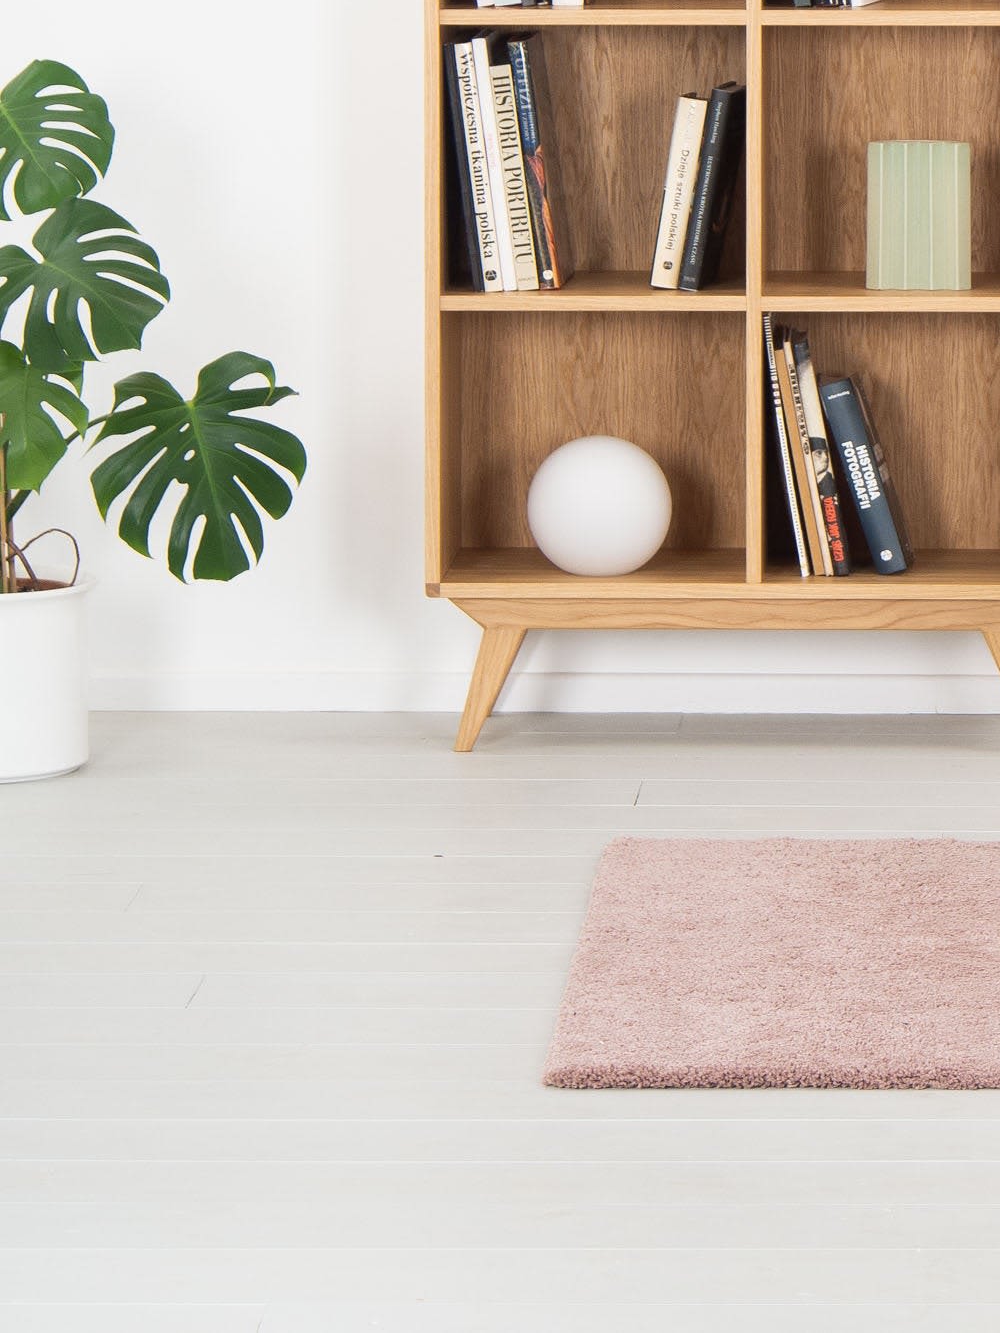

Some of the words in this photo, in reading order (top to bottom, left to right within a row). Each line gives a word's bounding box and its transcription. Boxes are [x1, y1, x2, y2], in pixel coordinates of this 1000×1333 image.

[493, 75, 519, 161] HISTORIA
[710, 121, 720, 144] Hawking
[471, 150, 488, 205] tkanina
[676, 149, 690, 179] Dzieje
[504, 167, 534, 264] PORTRETU
[672, 182, 683, 210] sztuki
[474, 212, 495, 258] polska
[665, 213, 678, 250] polskiej
[693, 219, 702, 246] HISTORIA
[690, 246, 698, 265] CZASU
[841, 440, 871, 510] FOTOGRAFII
[855, 444, 881, 501] HISTORIA
